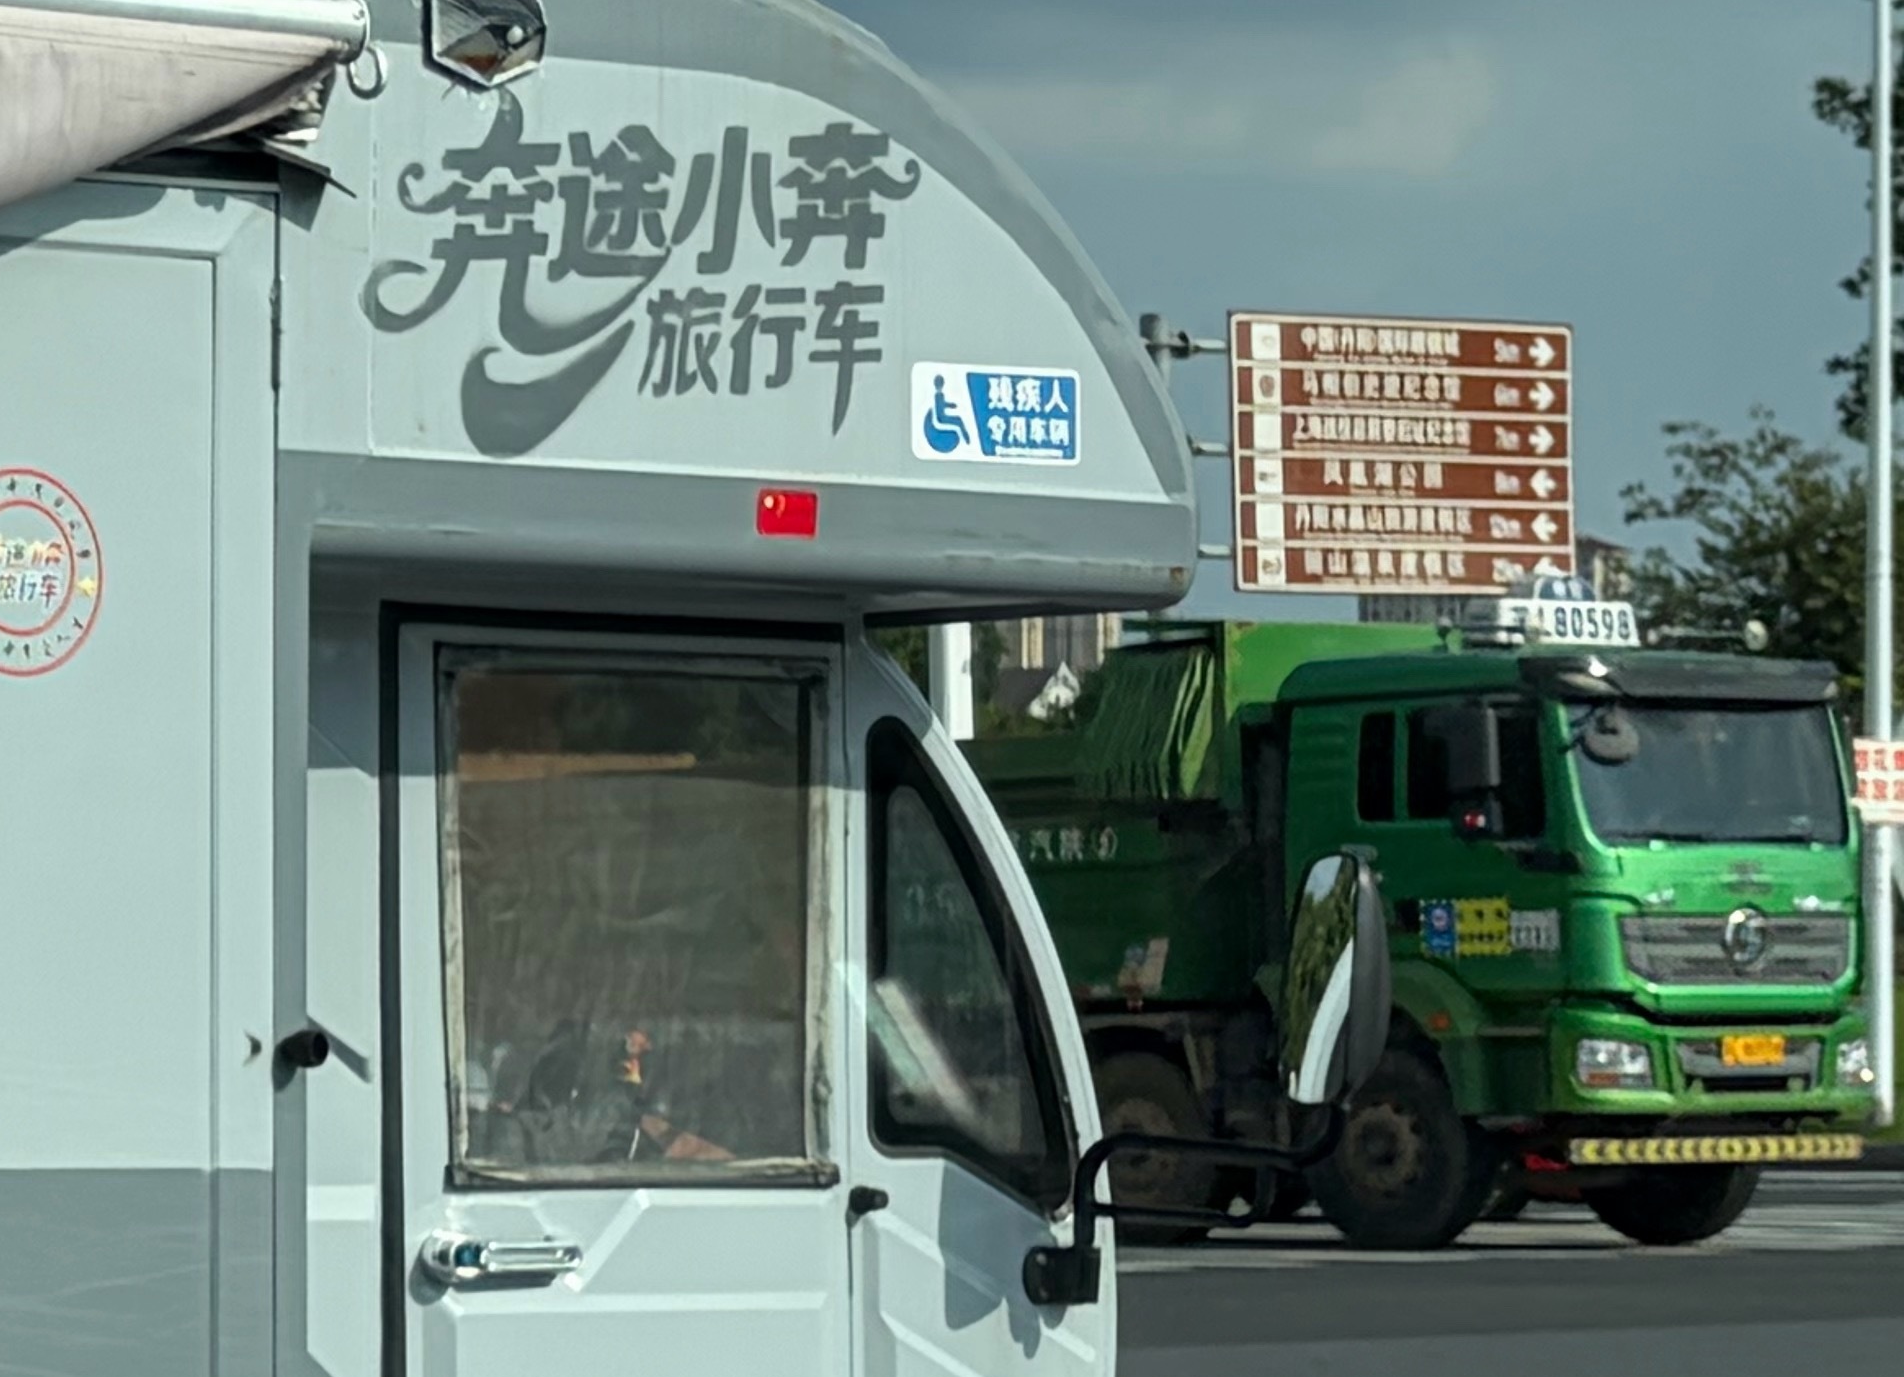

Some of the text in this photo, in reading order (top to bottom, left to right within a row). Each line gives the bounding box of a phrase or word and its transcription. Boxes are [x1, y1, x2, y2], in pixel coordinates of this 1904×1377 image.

[358, 88, 922, 358] 奔途小奔
[638, 280, 885, 436] 旅行车
[987, 375, 1069, 413] 残疾人
